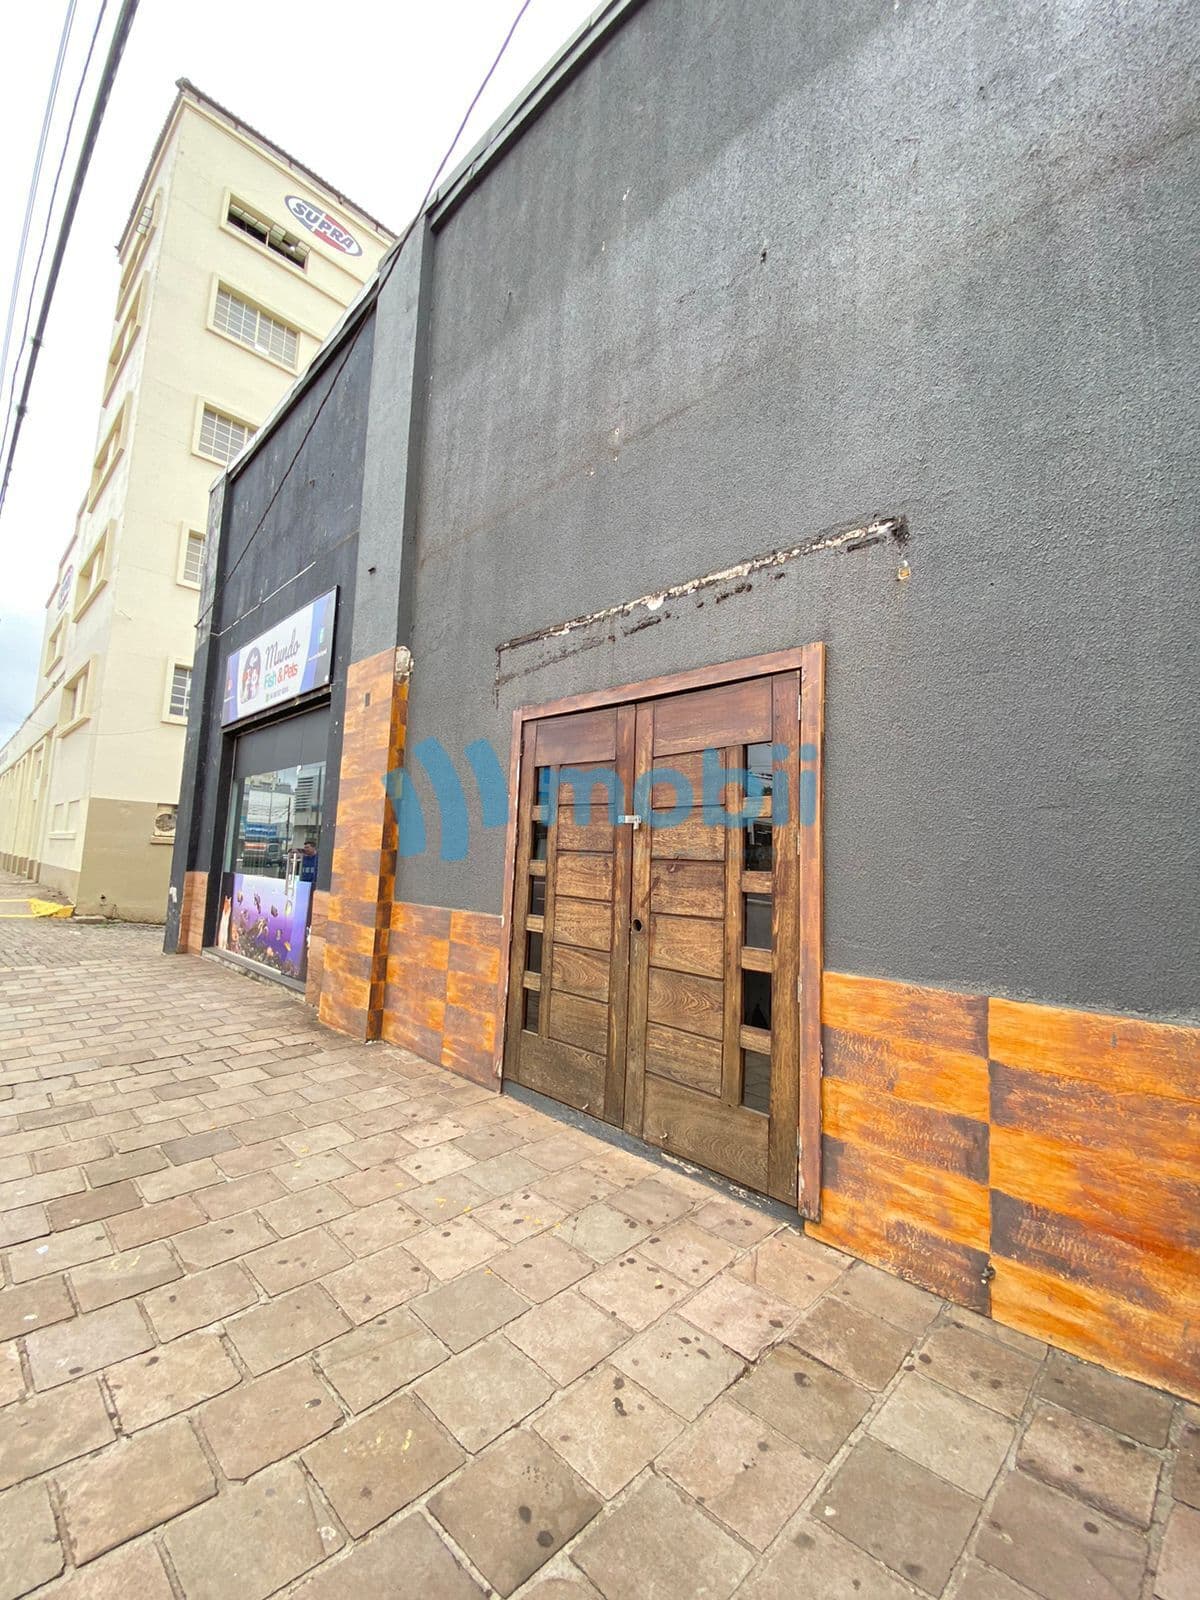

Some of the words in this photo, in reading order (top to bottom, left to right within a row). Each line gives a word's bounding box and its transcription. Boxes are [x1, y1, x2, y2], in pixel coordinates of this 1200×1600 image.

[293, 203, 354, 249] SUPRA
[265, 627, 300, 671] Mundo
[283, 664, 298, 681] Pets
